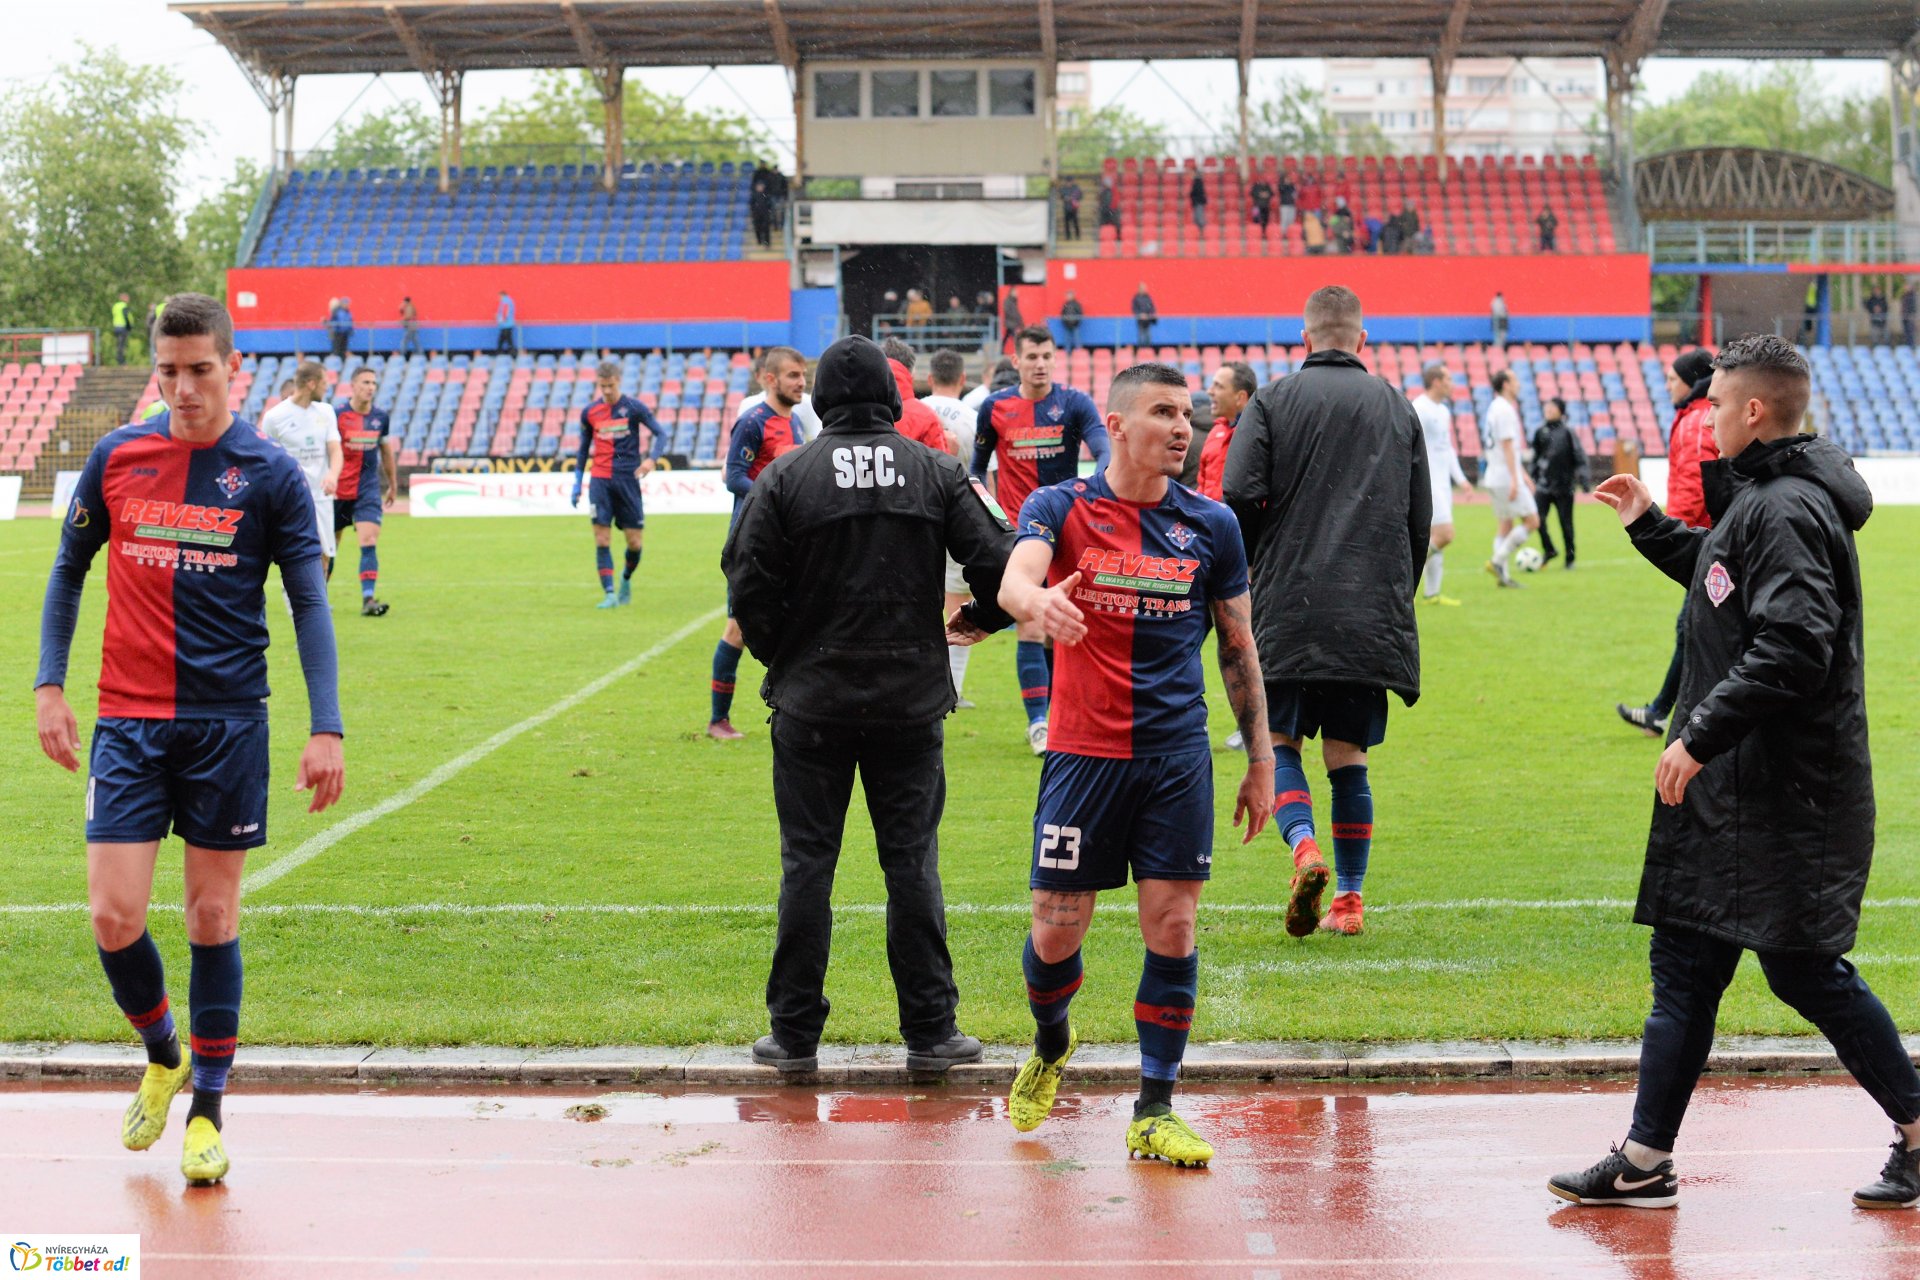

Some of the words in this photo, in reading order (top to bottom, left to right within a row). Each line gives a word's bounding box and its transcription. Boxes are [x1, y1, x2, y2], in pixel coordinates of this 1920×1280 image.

[832, 445, 906, 489] SEC.
[121, 541, 181, 561] LERTON
[182, 549, 238, 567] TRANS
[1096, 576, 1125, 584] ALWAYS
[1137, 580, 1151, 588] THE
[1151, 582, 1174, 590] RIGHT
[1075, 587, 1140, 608] LERTON
[1142, 597, 1192, 612] TRANS
[1038, 823, 1081, 870] 23
